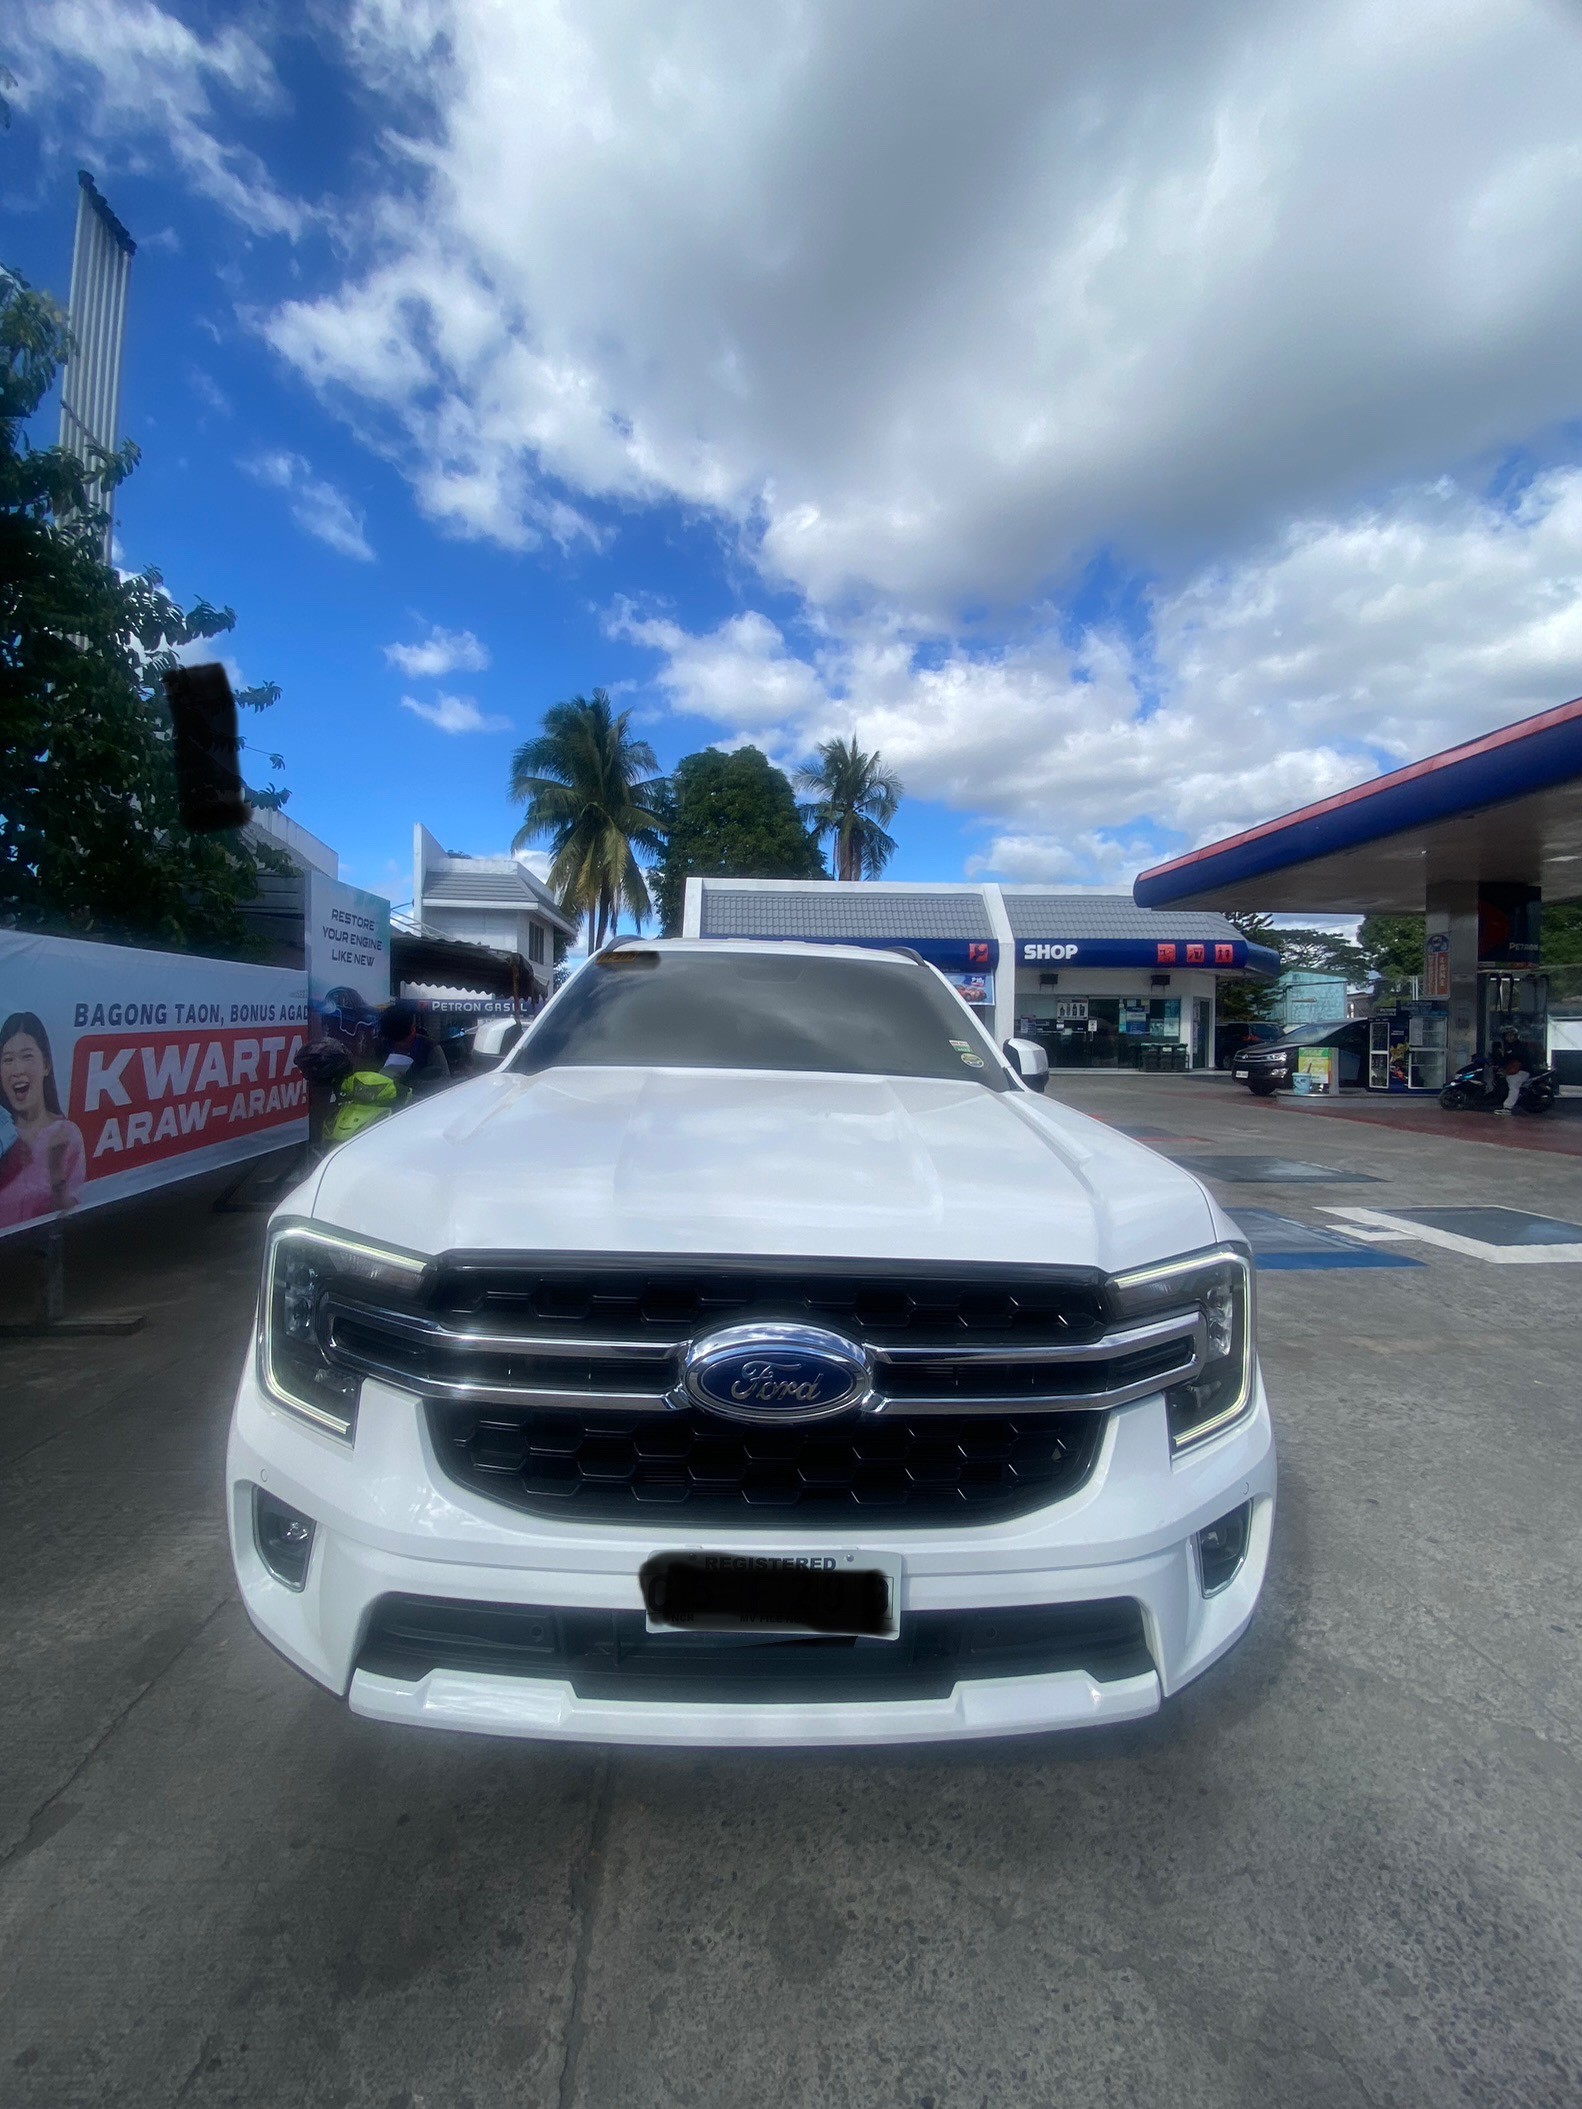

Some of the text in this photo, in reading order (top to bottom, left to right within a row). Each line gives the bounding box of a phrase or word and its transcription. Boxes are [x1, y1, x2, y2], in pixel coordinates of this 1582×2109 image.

[331, 908, 375, 931] RESTORE
[322, 925, 383, 951] YOUR ENGINE
[331, 948, 375, 967] LIKE NEW
[1024, 944, 1079, 960] SHOP
[73, 1003, 309, 1028] BAGONG TAON, BONUS AGAD
[431, 1000, 482, 1012] PETRON
[84, 1035, 303, 1113] KWARTA
[92, 1079, 308, 1158] ARAW-ARAW!
[730, 1360, 824, 1400] Ford
[705, 1556, 837, 1571] REGISTERED
